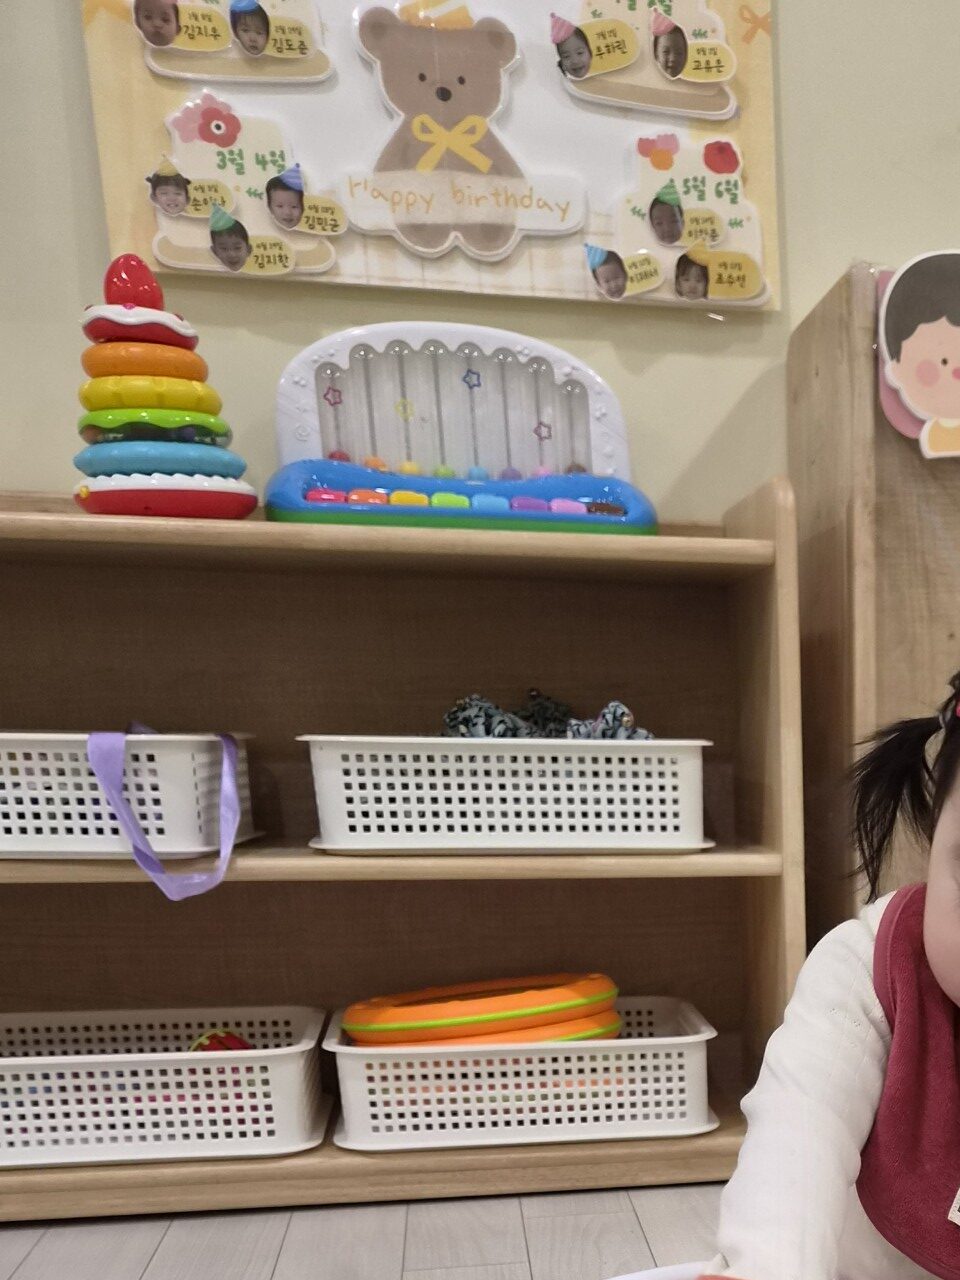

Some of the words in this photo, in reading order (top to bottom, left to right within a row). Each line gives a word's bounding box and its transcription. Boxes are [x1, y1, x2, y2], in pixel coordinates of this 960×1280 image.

[183, 24, 221, 41] 김지우
[216, 148, 245, 175] 3월
[255, 149, 286, 174] 4월
[348, 175, 435, 214] Happy
[450, 176, 571, 222] birthday
[682, 176, 706, 201] 5월
[714, 179, 739, 205] 6월
